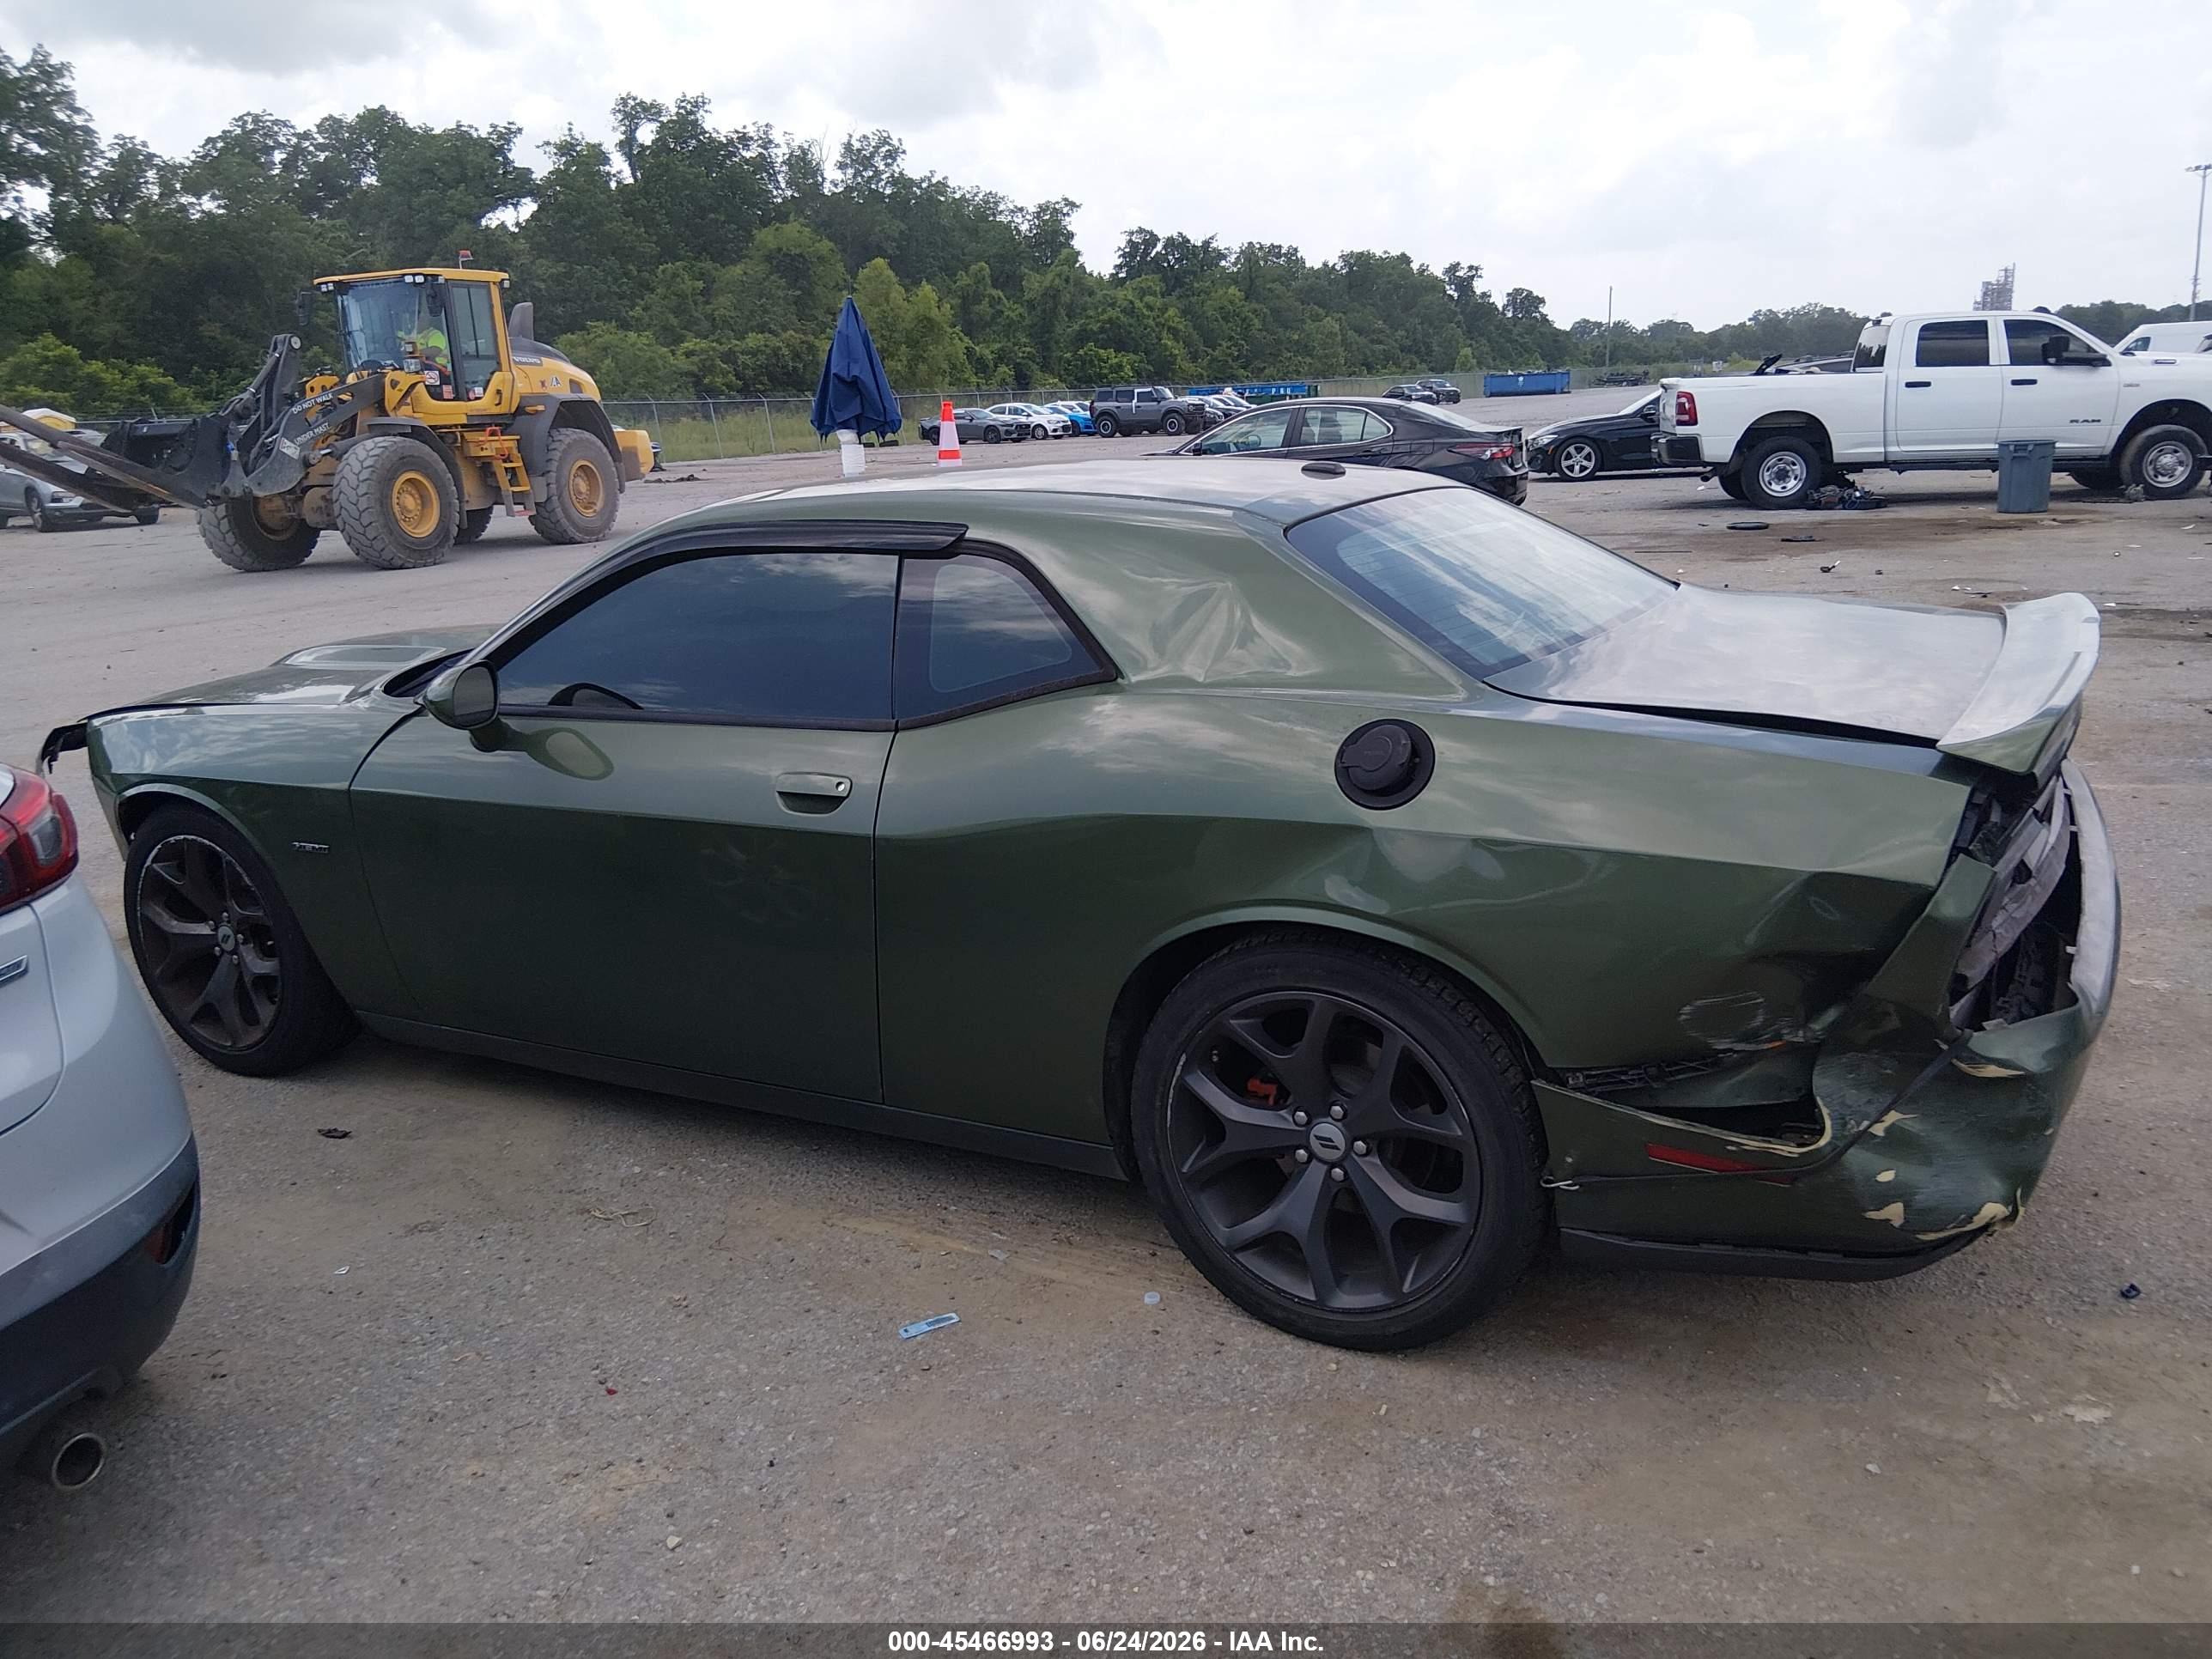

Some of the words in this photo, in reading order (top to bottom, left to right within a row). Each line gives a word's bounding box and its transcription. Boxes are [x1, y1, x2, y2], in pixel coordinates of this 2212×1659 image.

[292, 405, 302, 414] DO
[302, 399, 315, 410] NOT
[316, 392, 333, 404] WALK
[294, 430, 314, 445] UNDER
[313, 422, 331, 434] MAST
